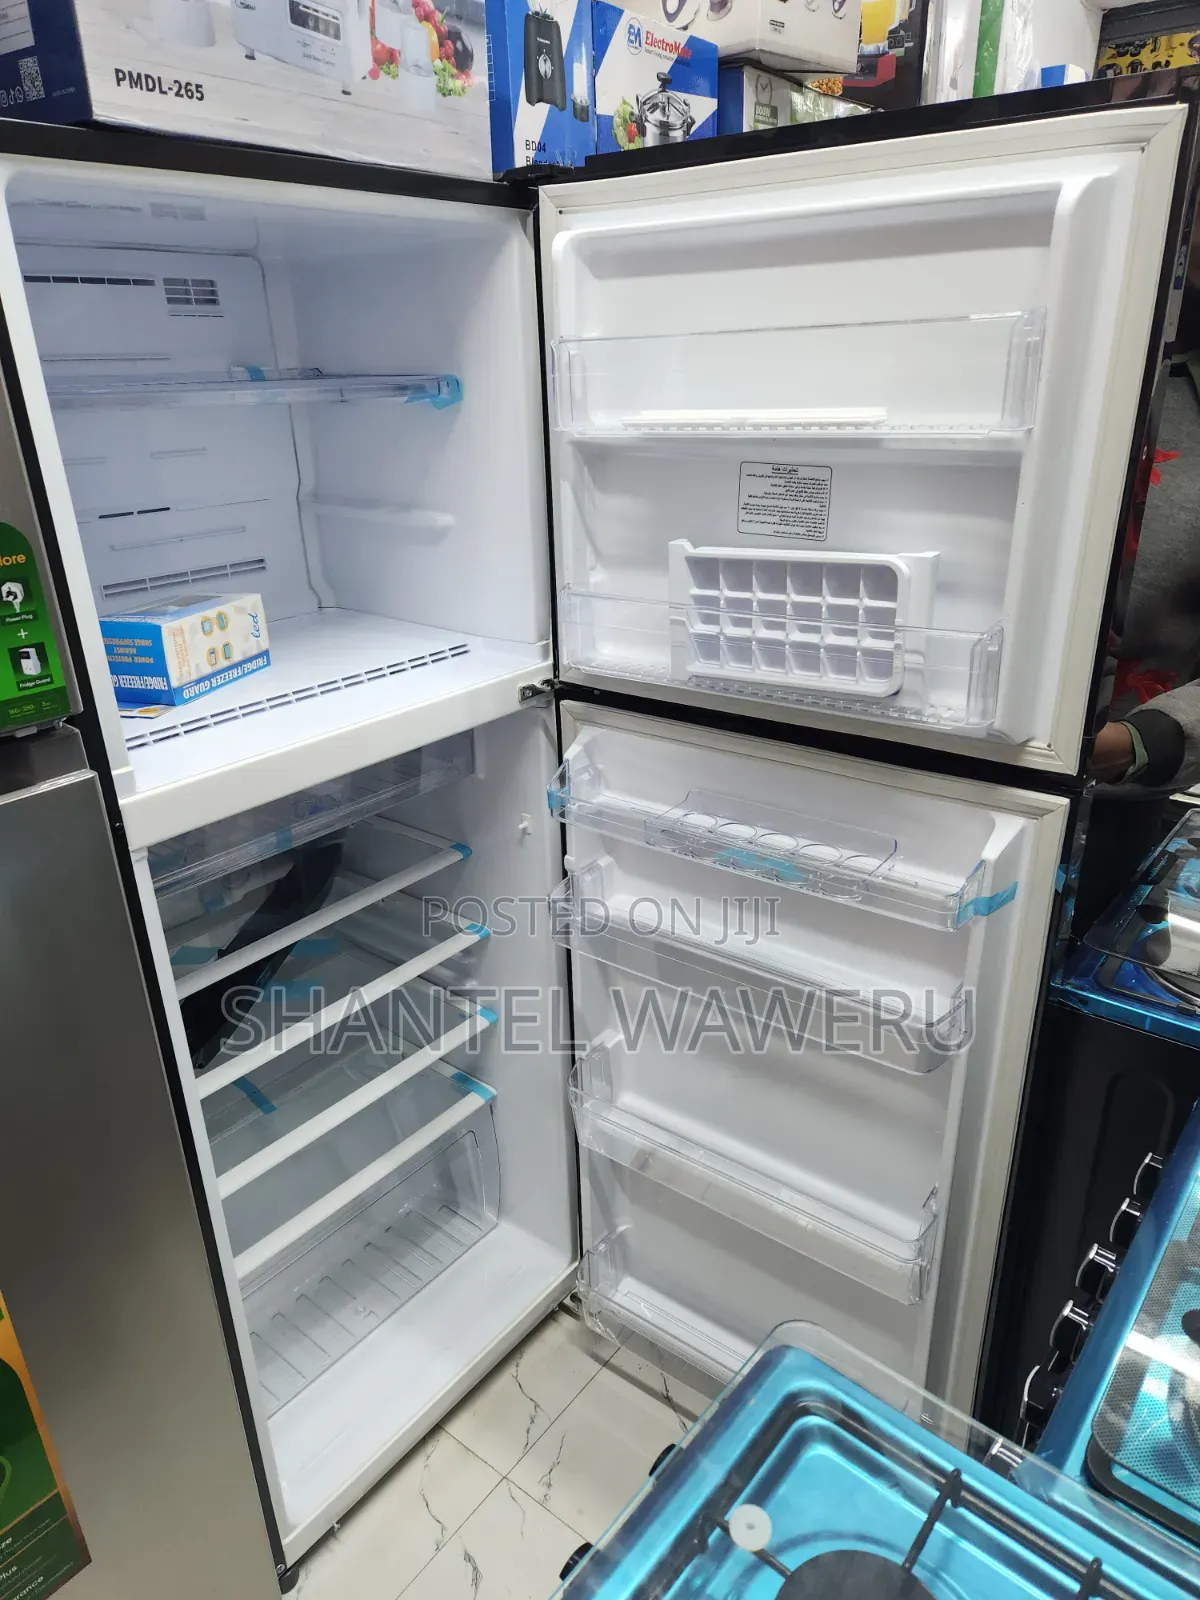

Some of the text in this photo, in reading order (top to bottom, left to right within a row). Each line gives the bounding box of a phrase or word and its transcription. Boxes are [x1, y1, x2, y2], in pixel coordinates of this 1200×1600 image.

[114, 68, 205, 101] PMDL-265
[525, 139, 546, 153] BD04
[5, 613, 33, 623] Power Plug
[19, 677, 51, 689] Fridge Guard
[119, 674, 169, 690] FRIDGE/FREEZER
[183, 655, 269, 699] FRIDGE/FREEZER GUARD
